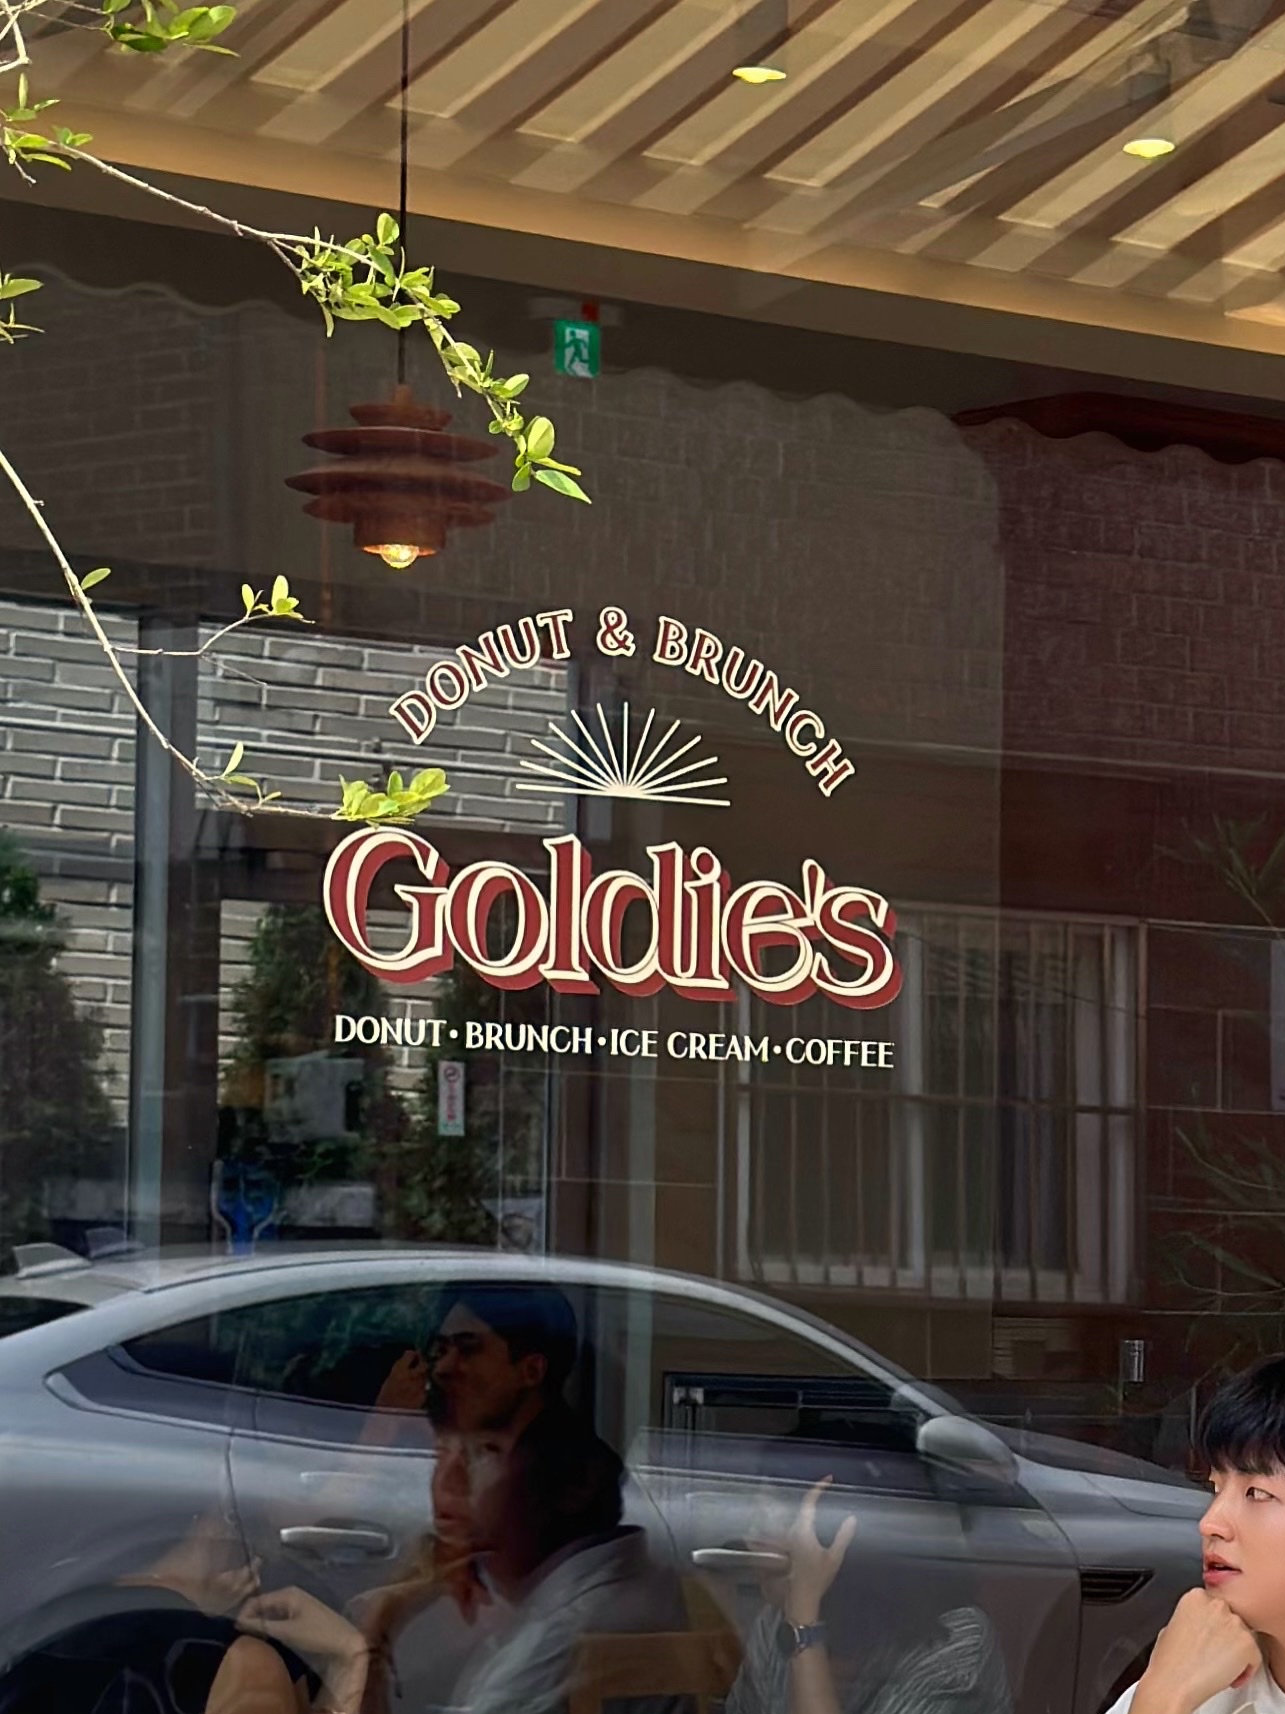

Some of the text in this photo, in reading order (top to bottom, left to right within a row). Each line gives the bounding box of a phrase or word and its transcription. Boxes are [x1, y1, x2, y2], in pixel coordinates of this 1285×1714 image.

[388, 606, 856, 798] DONUT & BRUNCH
[323, 826, 902, 1010] Goldie's
[334, 1013, 895, 1069] DONUT BRUNCH ICE CREAM COFFEE
